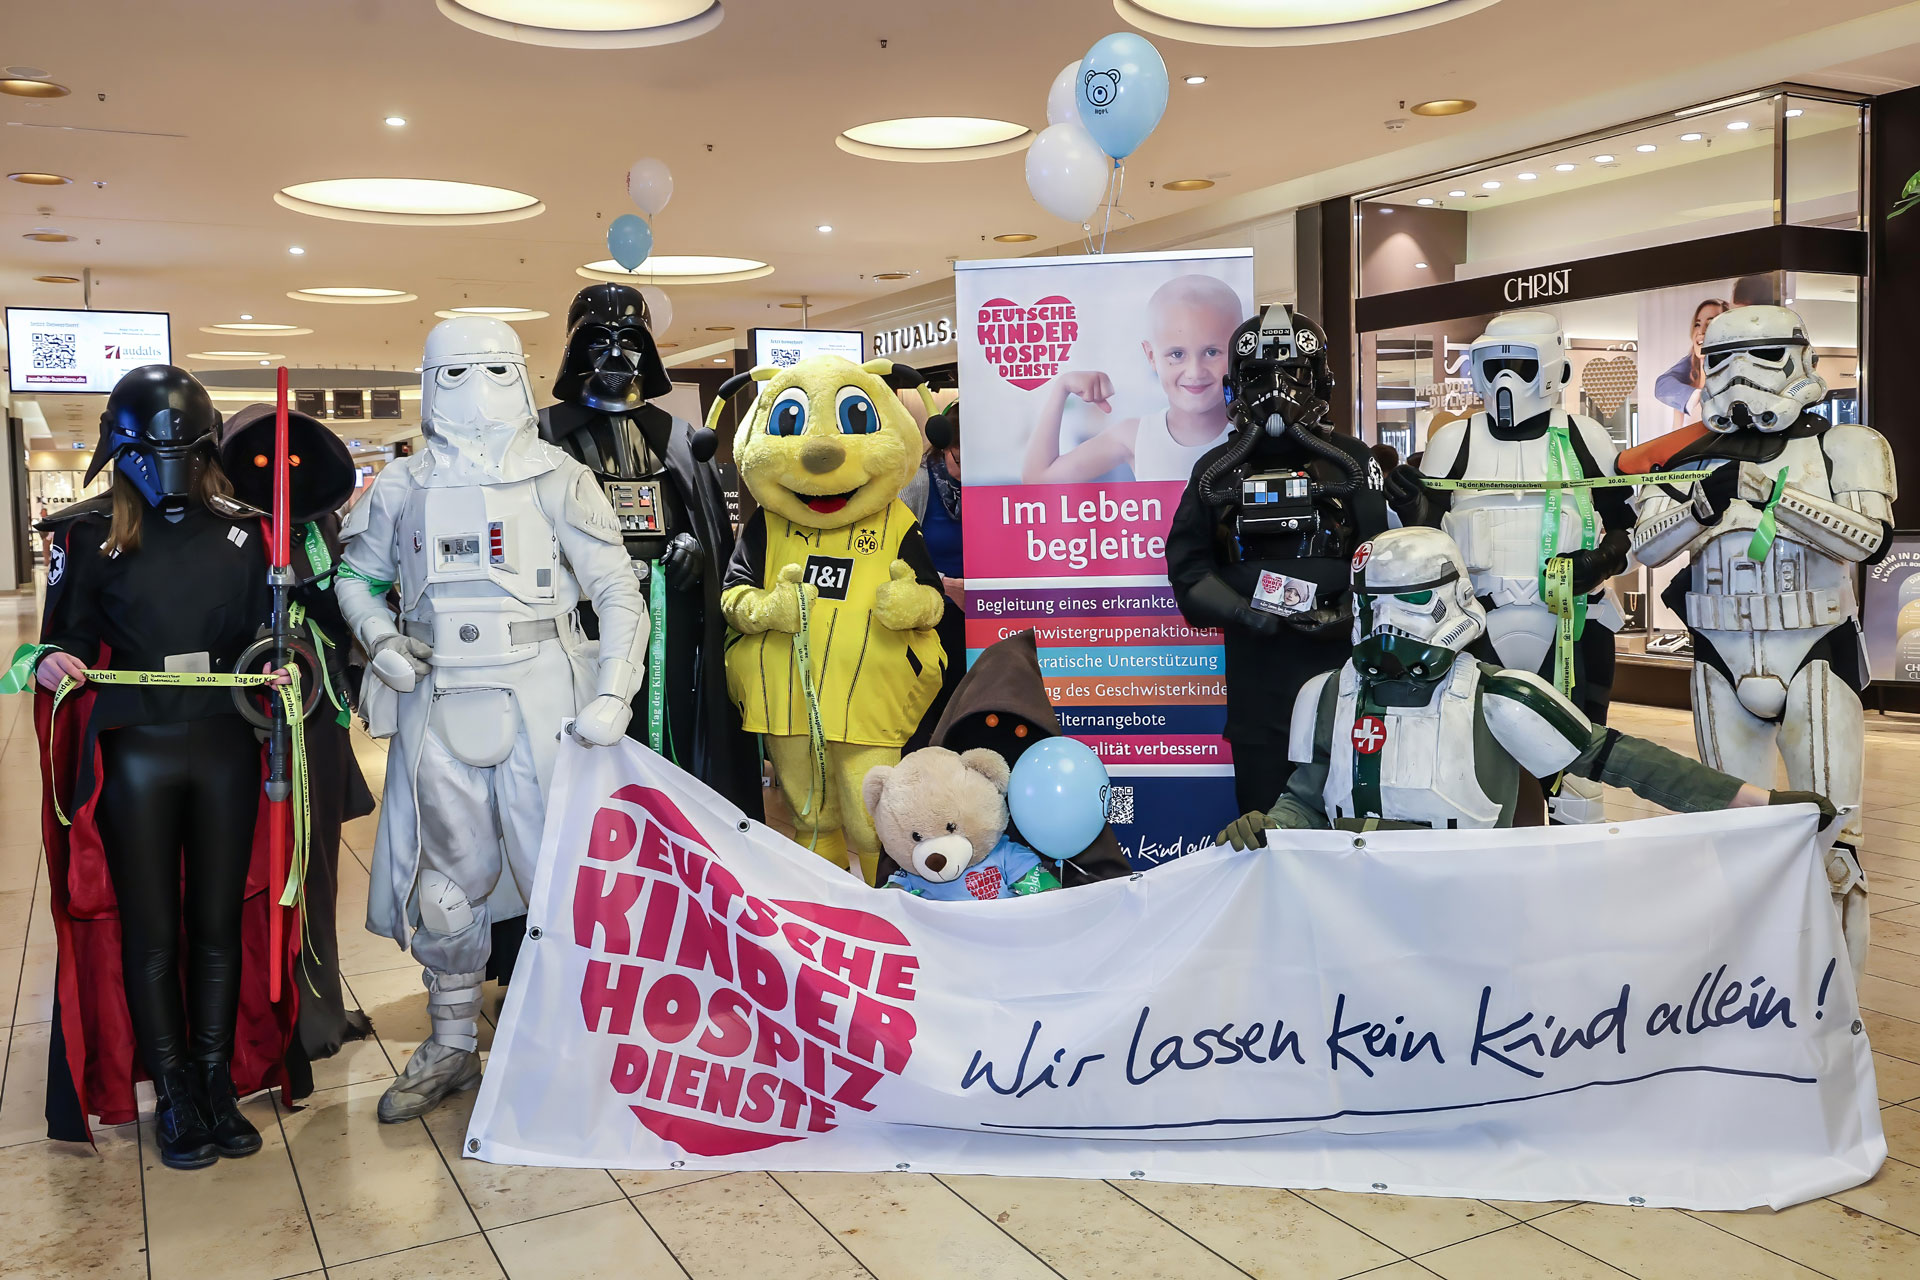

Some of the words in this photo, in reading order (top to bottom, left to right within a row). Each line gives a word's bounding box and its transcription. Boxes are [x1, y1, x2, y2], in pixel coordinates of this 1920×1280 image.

[1503, 268, 1573, 303] CHRIST
[978, 306, 1077, 324] DEUTSCHE
[977, 321, 1079, 346] KINDER
[122, 345, 162, 357] audalis
[985, 343, 1072, 365] HOSPIZ
[998, 363, 1059, 378] DIENSTE
[1641, 475, 1654, 483] Tag
[1002, 496, 1047, 525] Im
[1060, 490, 1162, 523] Leben
[857, 536, 876, 550] BVB
[1027, 528, 1166, 570] begleite
[1871, 554, 1897, 579] KOMM
[1898, 552, 1910, 560] IN
[809, 564, 847, 589] 1&1
[977, 599, 1055, 615] Begleitung
[1059, 597, 1097, 610] eines
[1108, 652, 1218, 671] Unterstützung
[234, 676, 248, 685] Tag
[249, 676, 262, 684] der
[1066, 683, 1090, 697] des
[1095, 681, 1228, 697] Geschwisterkinde
[651, 689, 661, 705] der
[652, 708, 662, 728] Tag
[1134, 741, 1218, 756] verbessern
[1138, 834, 1183, 864] Kind
[970, 880, 1002, 897] HOSPIZ
[587, 807, 920, 1001] DEUTSCHE
[573, 865, 917, 1076] KINDER
[580, 959, 886, 1112] HOSPIZ
[961, 1020, 1105, 1098] Wir
[1470, 985, 1630, 1078] Kind
[610, 1043, 839, 1133] DIENSTE
